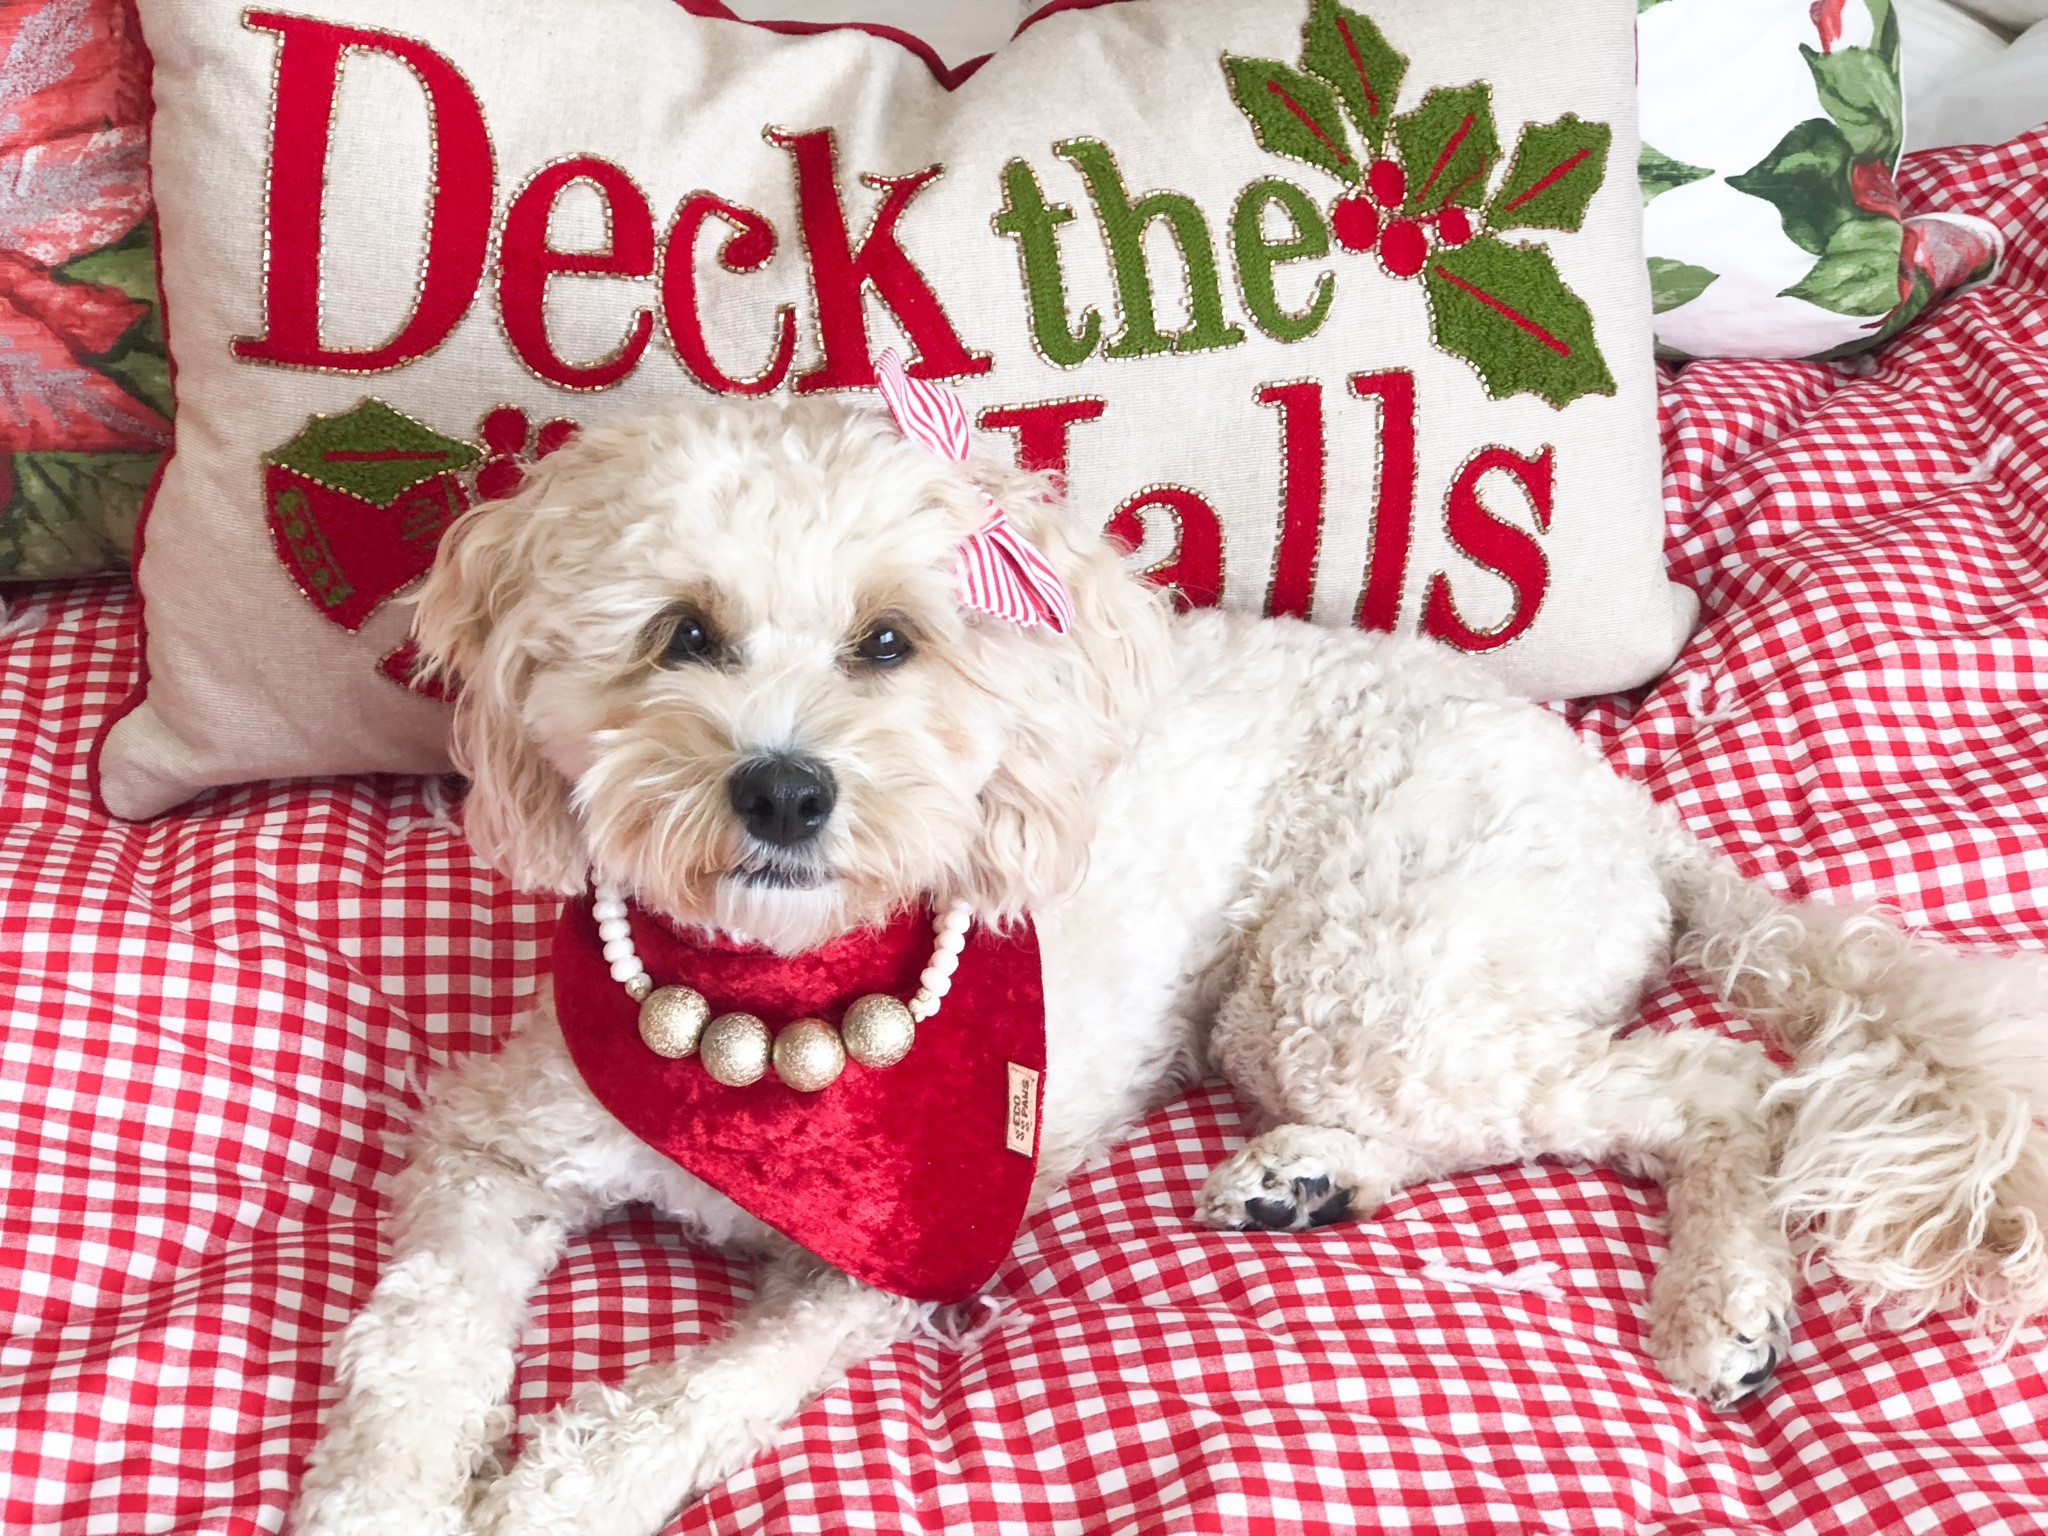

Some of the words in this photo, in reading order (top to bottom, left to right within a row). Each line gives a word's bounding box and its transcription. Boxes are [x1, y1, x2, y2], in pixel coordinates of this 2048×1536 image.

[230, 4, 995, 397] Deck
[991, 135, 1338, 370] the
[975, 366, 1558, 655] alls
[1013, 1095, 1021, 1126] ECO
[1021, 1079, 1029, 1118] PAWS
